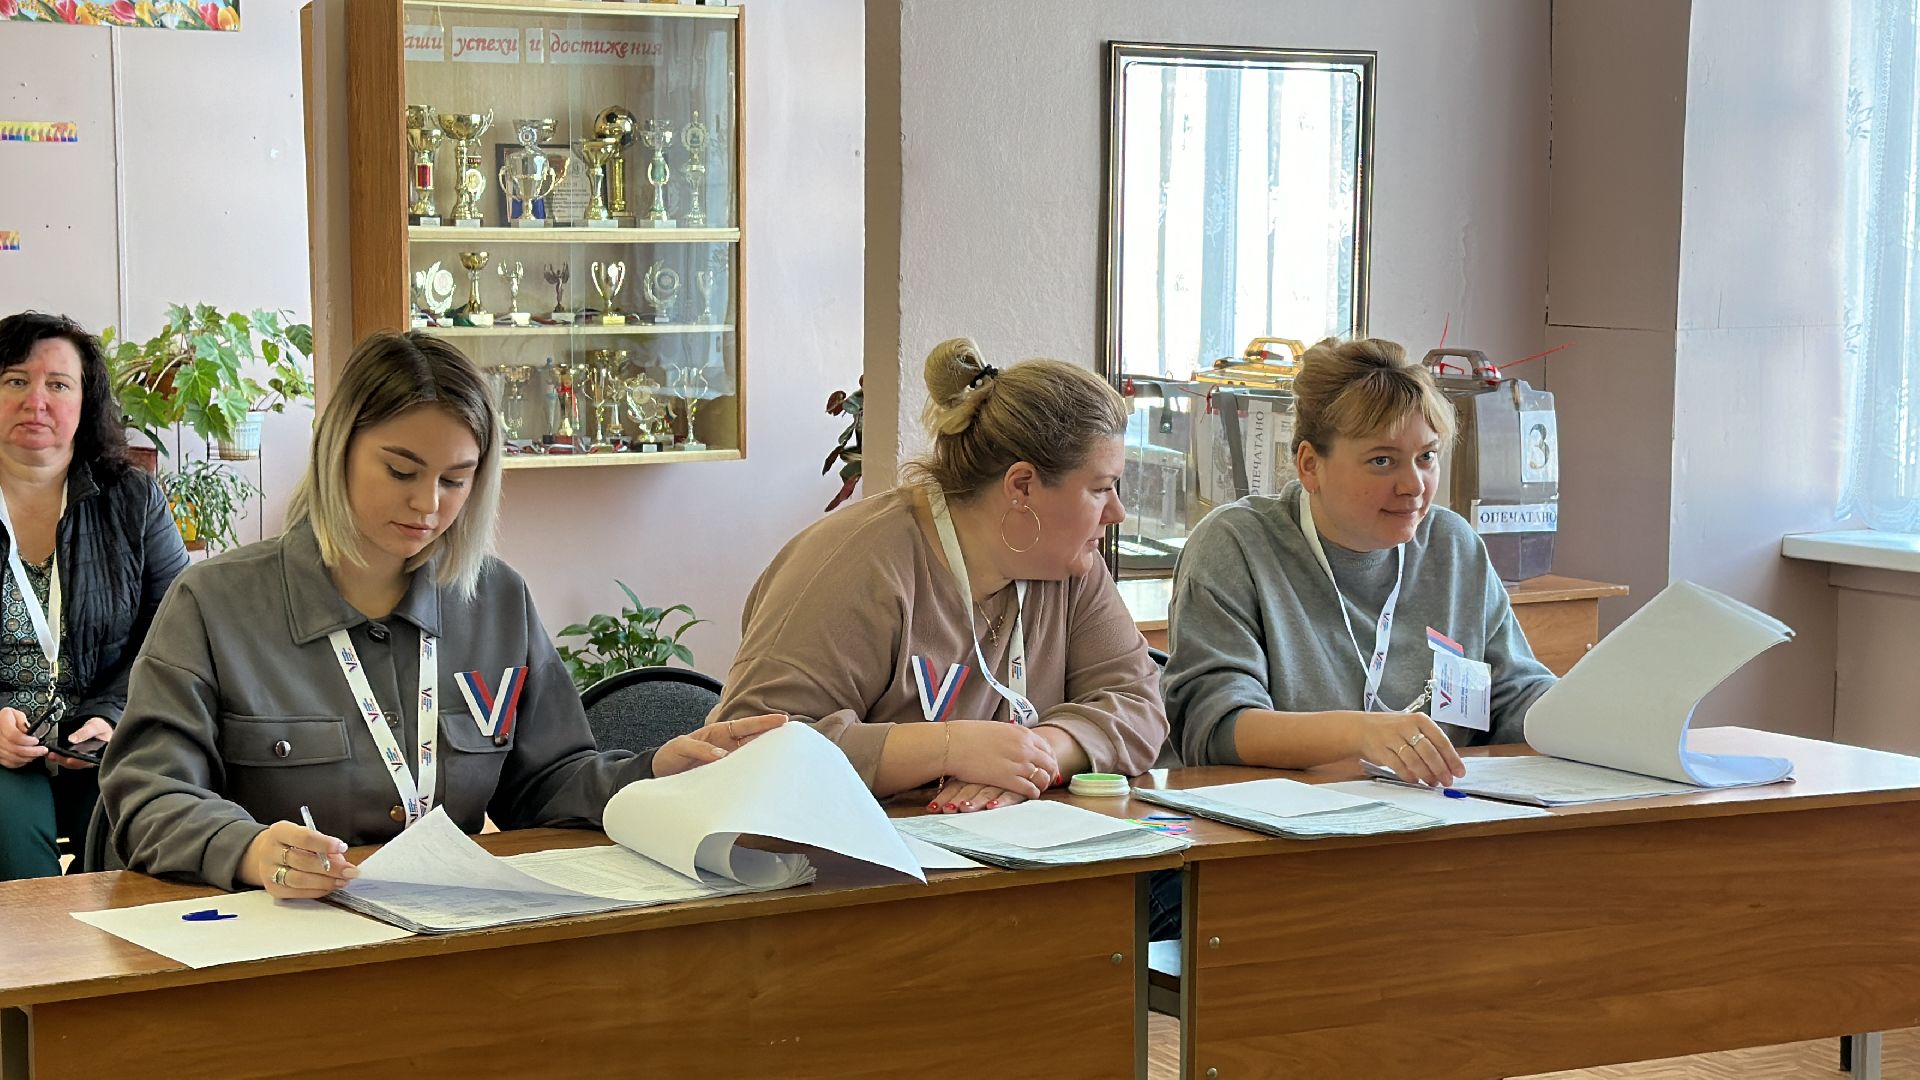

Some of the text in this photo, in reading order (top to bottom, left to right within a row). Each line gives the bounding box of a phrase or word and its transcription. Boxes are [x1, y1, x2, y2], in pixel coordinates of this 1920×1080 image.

[404, 32, 663, 59] аши успехи и достижения
[1529, 423, 1550, 470] 3
[1479, 510, 1557, 524] ОПЕЧАТАНО
